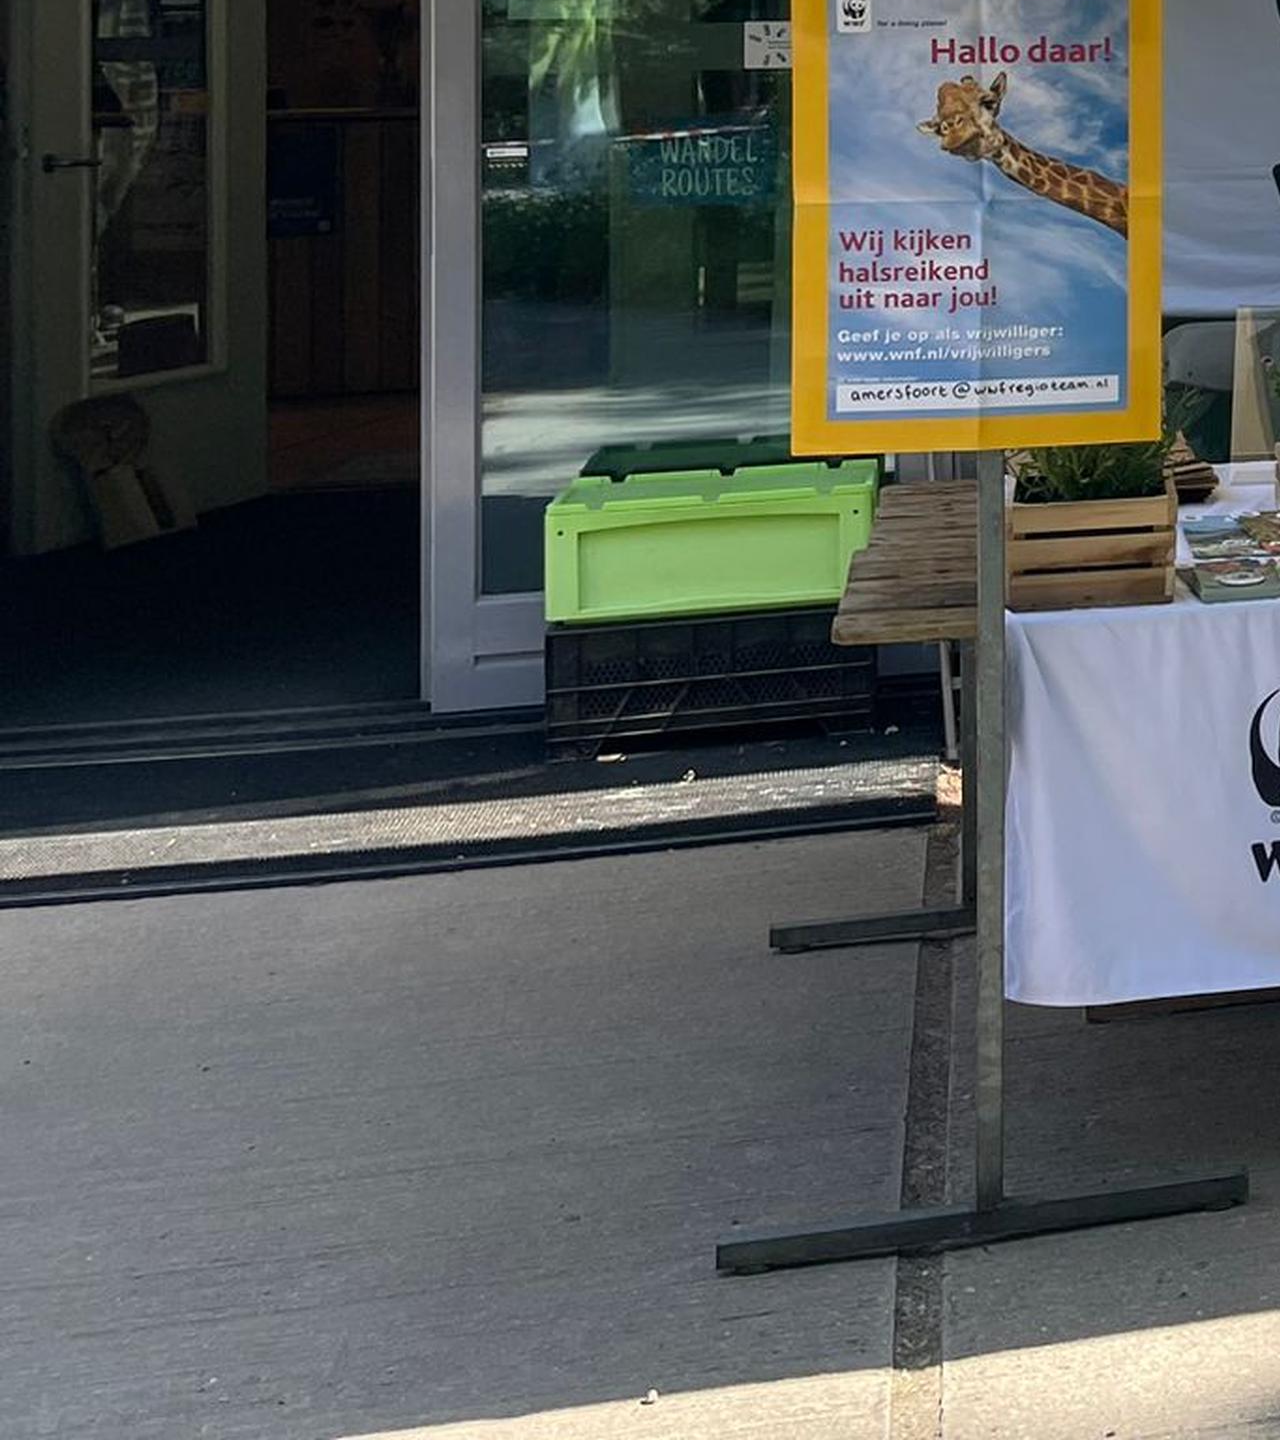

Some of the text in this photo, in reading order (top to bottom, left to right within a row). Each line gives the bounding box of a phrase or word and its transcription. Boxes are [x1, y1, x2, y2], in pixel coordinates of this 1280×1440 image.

[931, 36, 1113, 65] Hallo daar!
[659, 138, 758, 163] WANDEL
[661, 168, 756, 197] ROUTES
[839, 228, 972, 258] Wij kijken
[839, 258, 990, 283] halsreikend
[839, 288, 998, 313] uit naar jou!
[838, 324, 1064, 346] Geef je op als vrijwilliger:
[837, 343, 1051, 363] www.wnf.nl/vrijwilligers
